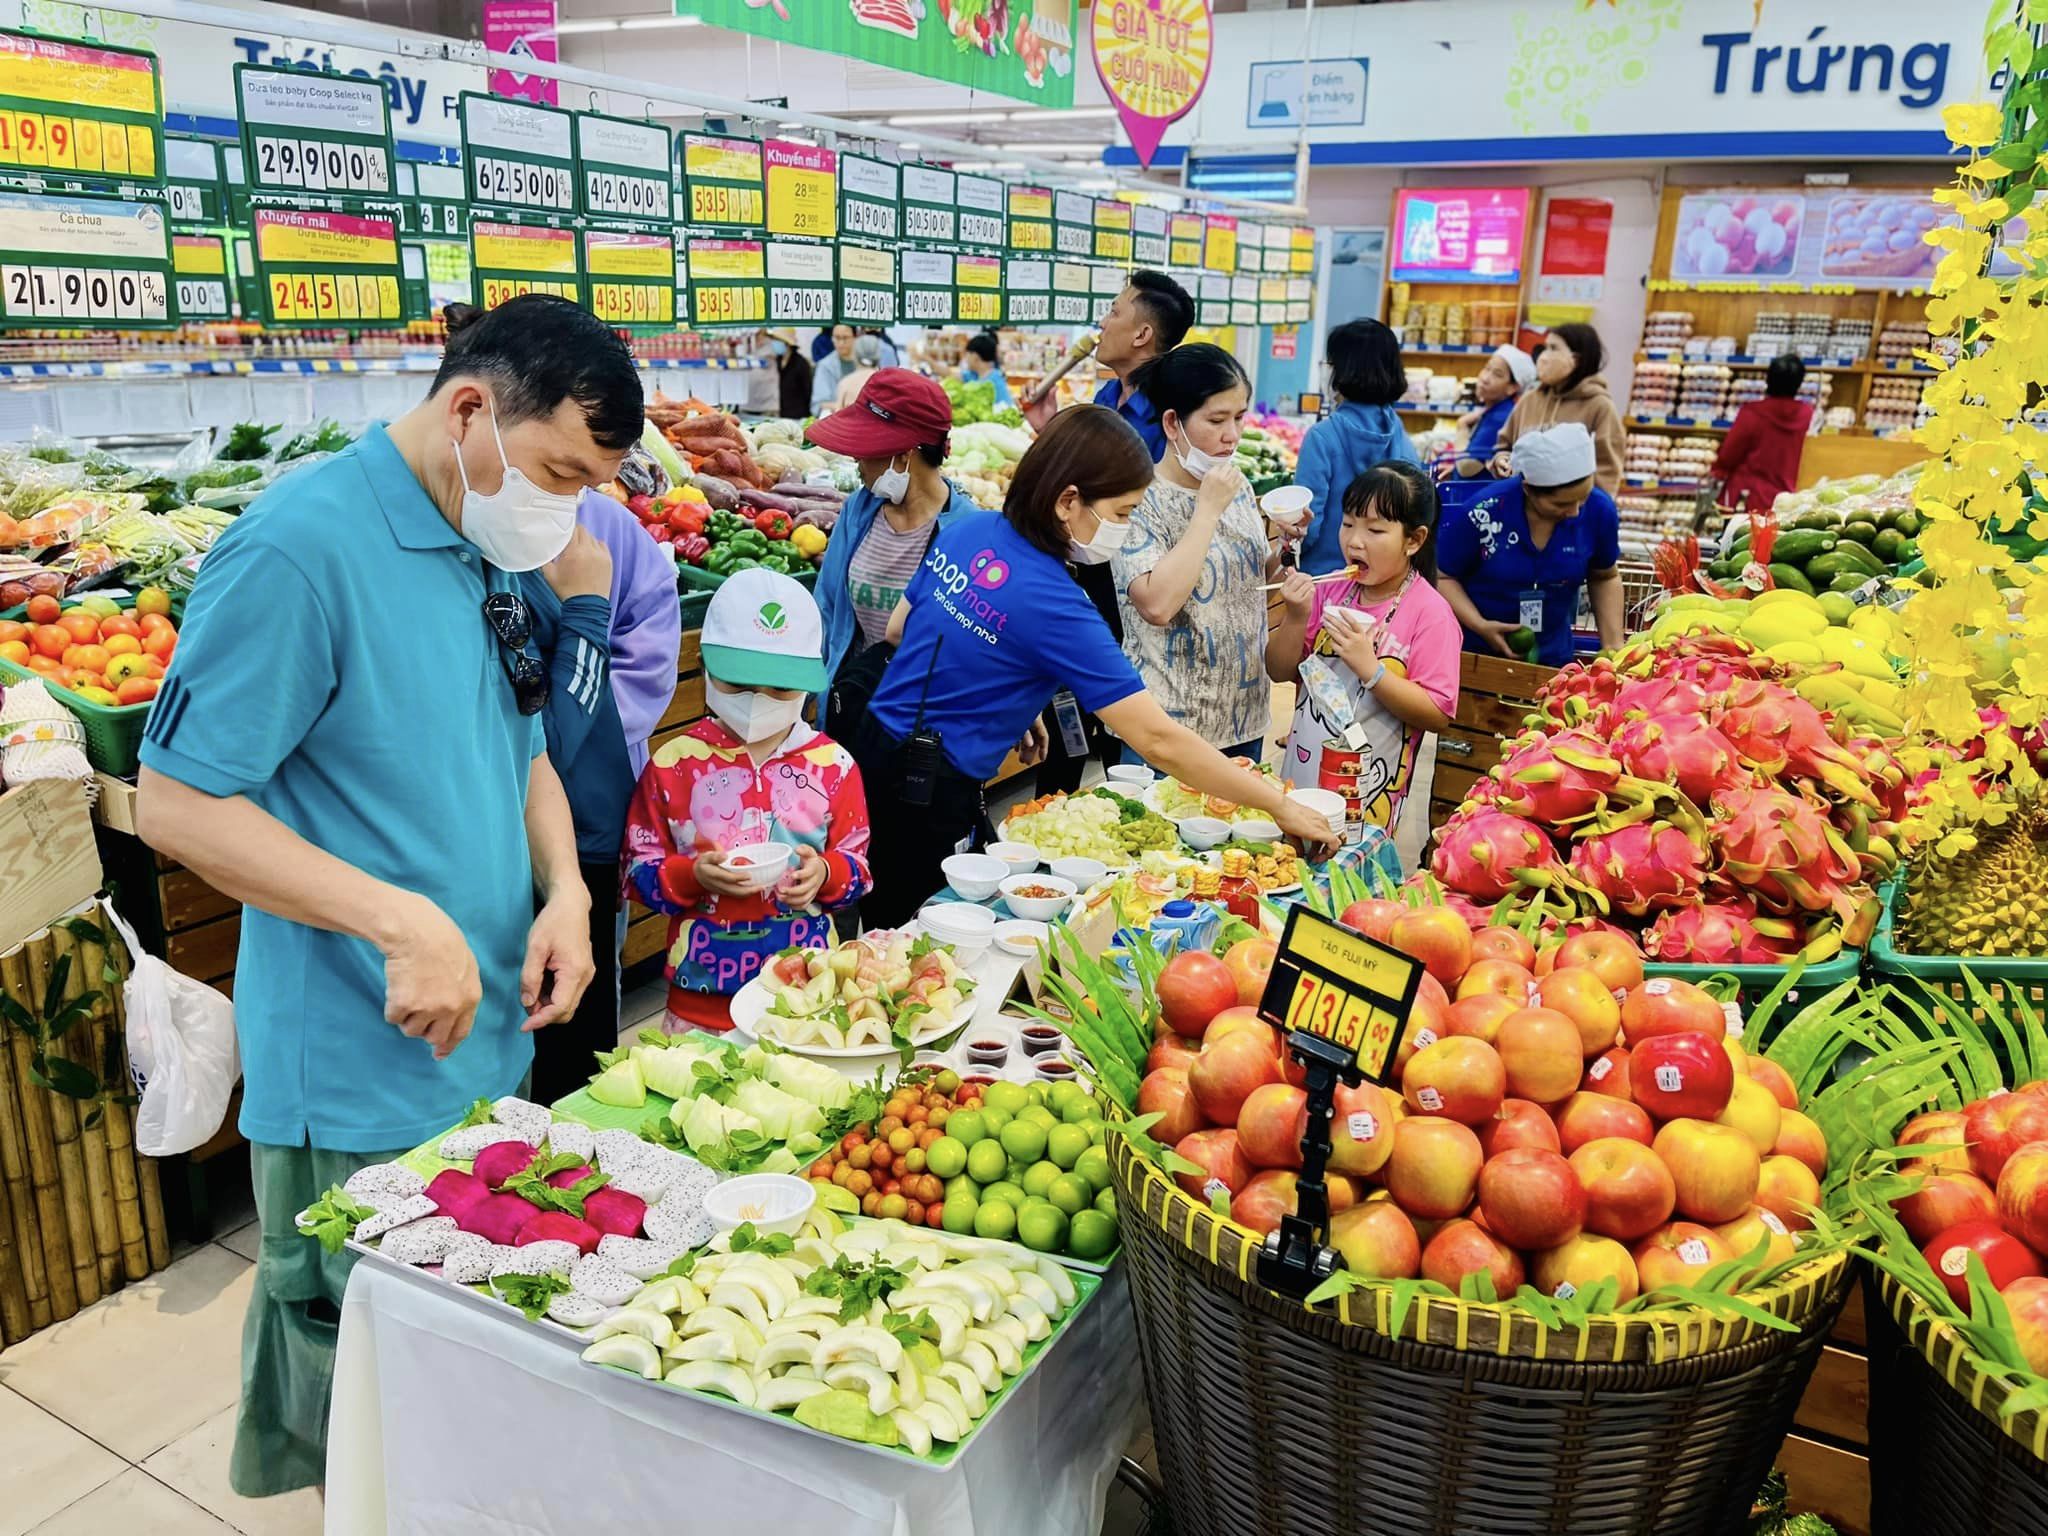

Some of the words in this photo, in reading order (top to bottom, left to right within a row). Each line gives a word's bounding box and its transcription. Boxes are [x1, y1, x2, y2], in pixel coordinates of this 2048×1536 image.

[1702, 26, 1950, 108] Trứng
[309, 87, 332, 101] Coop
[334, 90, 360, 101] Select
[361, 92, 372, 104] kg
[260, 143, 364, 181] 29.900
[479, 163, 554, 199] 62.500
[590, 177, 654, 209] 42.000
[794, 182, 807, 198] 28
[77, 214, 102, 226] chua
[259, 210, 304, 226] Khuyến
[793, 212, 807, 228] 23
[11, 273, 135, 307] 21.900
[276, 281, 375, 310] 24.500
[774, 292, 822, 313] 12.900
[960, 588, 1008, 631] mart
[1341, 950, 1363, 966] FUJI
